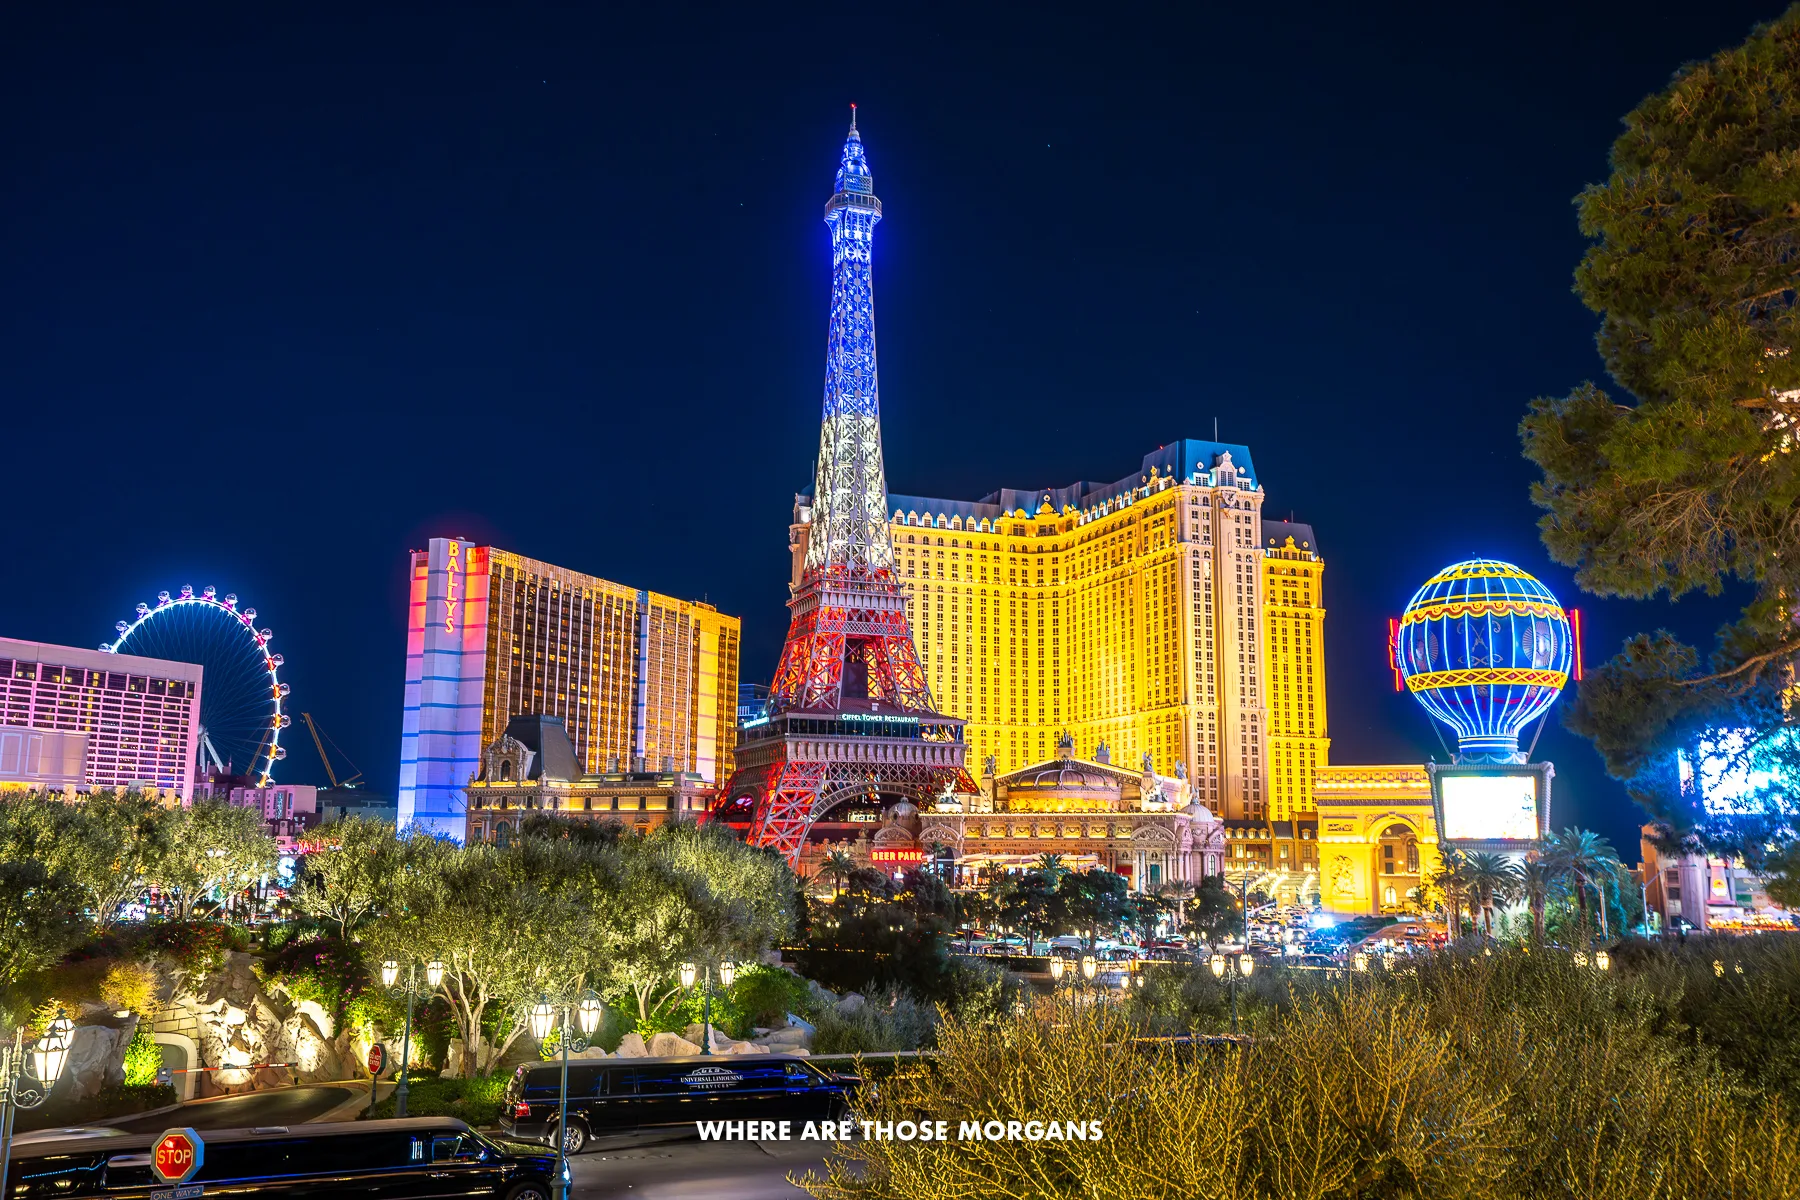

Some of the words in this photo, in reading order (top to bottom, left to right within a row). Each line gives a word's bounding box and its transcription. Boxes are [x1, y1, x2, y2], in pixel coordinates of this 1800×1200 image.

[841, 713, 861, 721] EIFFEL
[862, 714, 882, 722] TOWER
[884, 715, 919, 723] RESTAURANT
[872, 851, 896, 861] BEER
[897, 851, 923, 861] PARK
[157, 1149, 192, 1165] STOP
[153, 1191, 173, 1200] ONE
[176, 1189, 192, 1198] WAY
